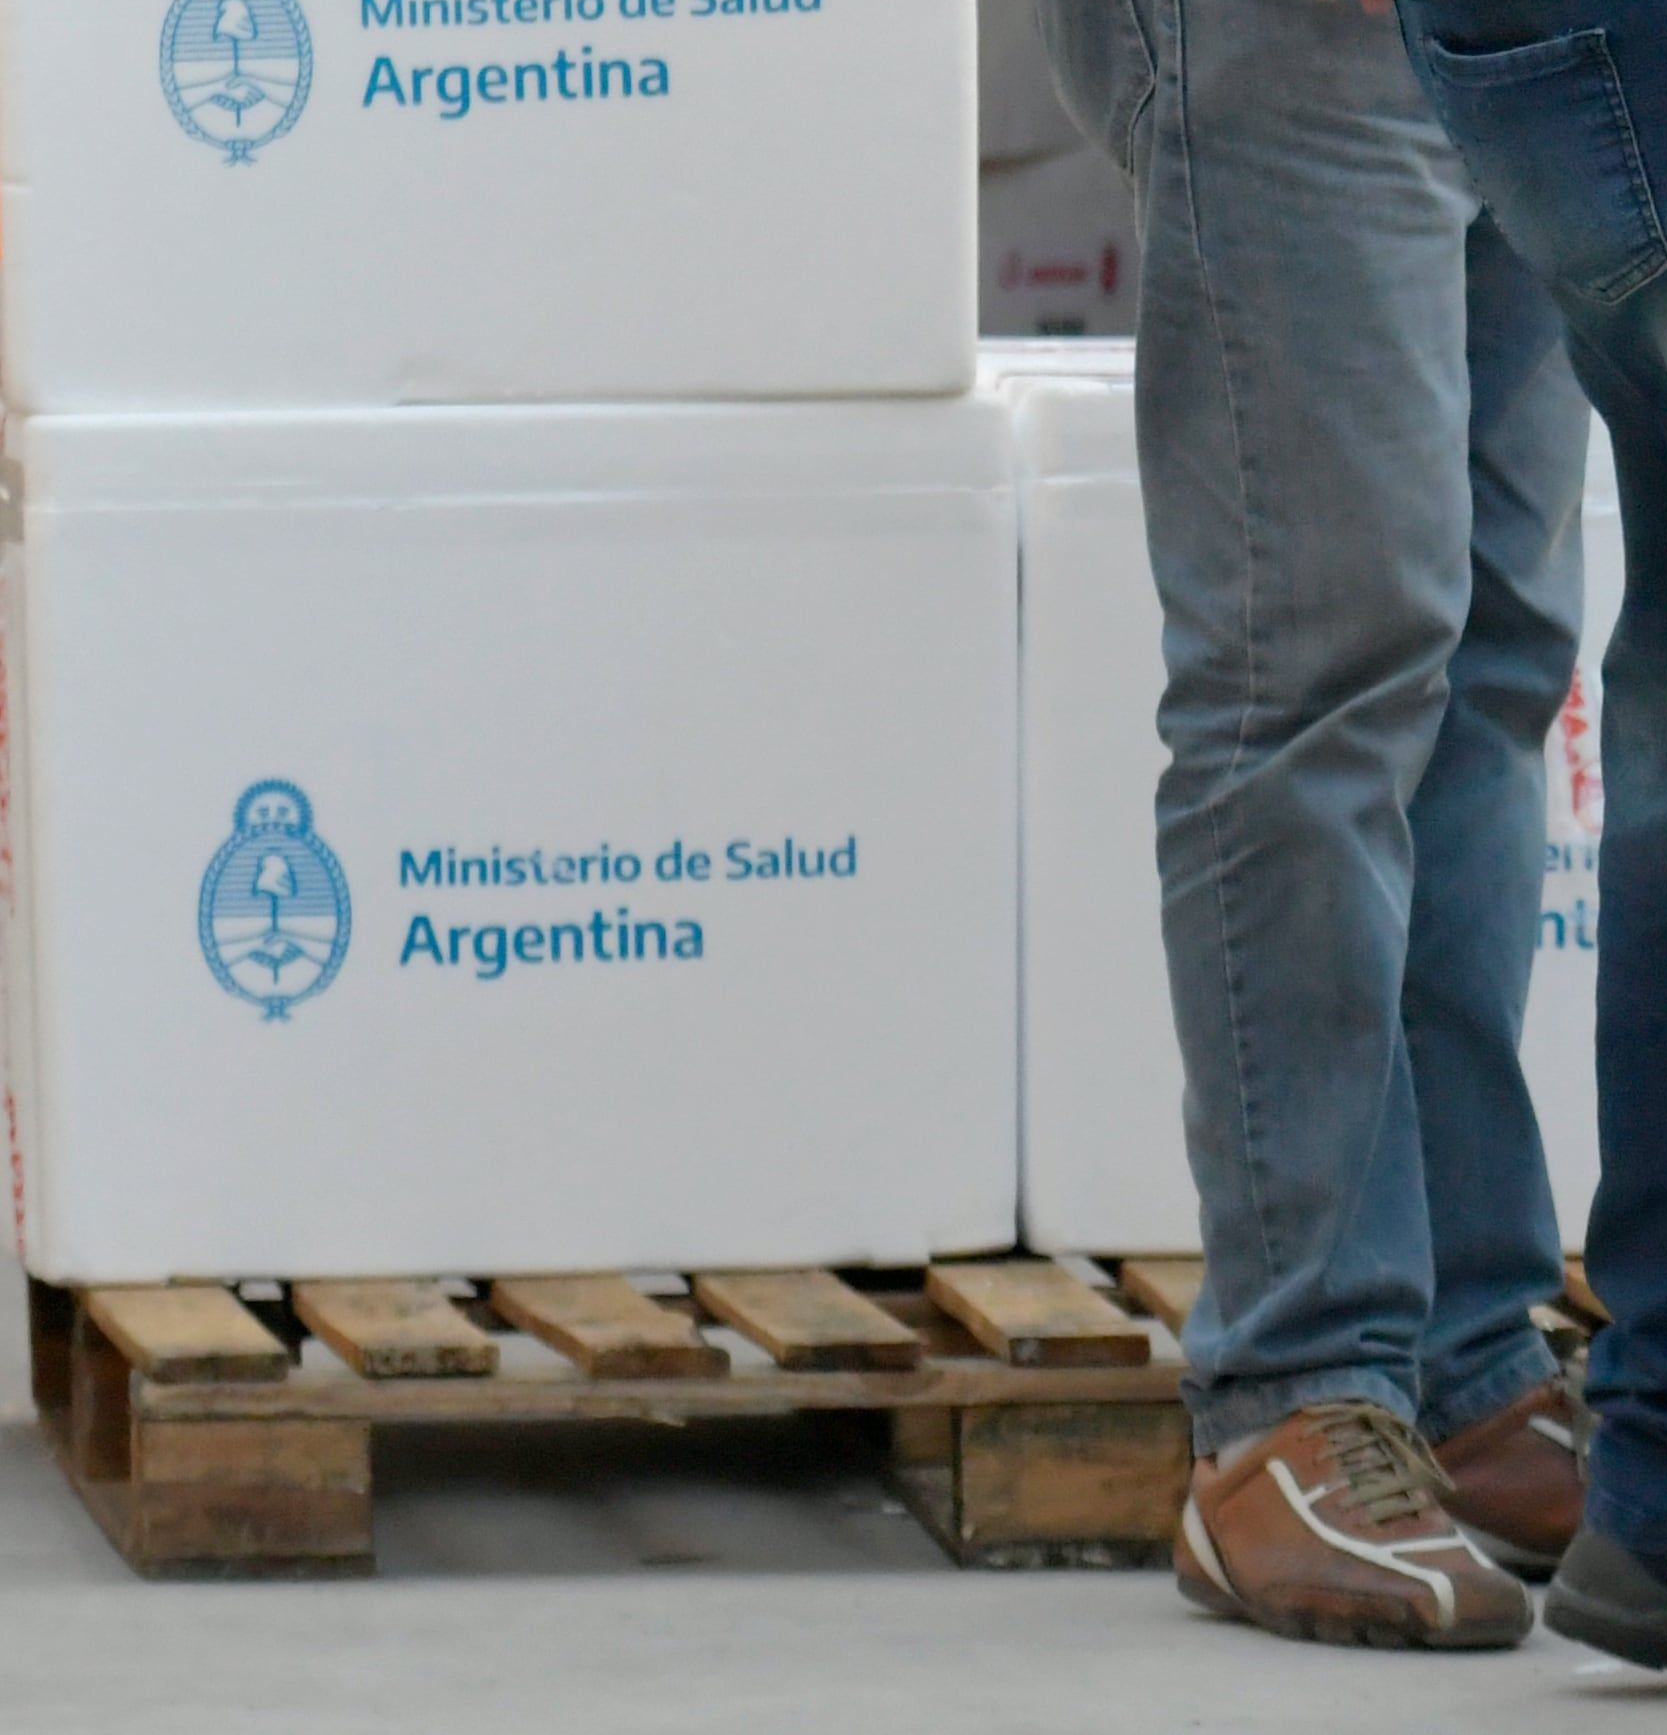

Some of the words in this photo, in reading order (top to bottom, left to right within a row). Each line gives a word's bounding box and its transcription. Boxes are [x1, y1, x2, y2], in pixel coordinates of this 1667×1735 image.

[361, 45, 670, 120] Argentina
[399, 842, 642, 887] Ministerio
[655, 840, 711, 882] de
[725, 834, 858, 881] Salud
[399, 906, 706, 981] Argentina
